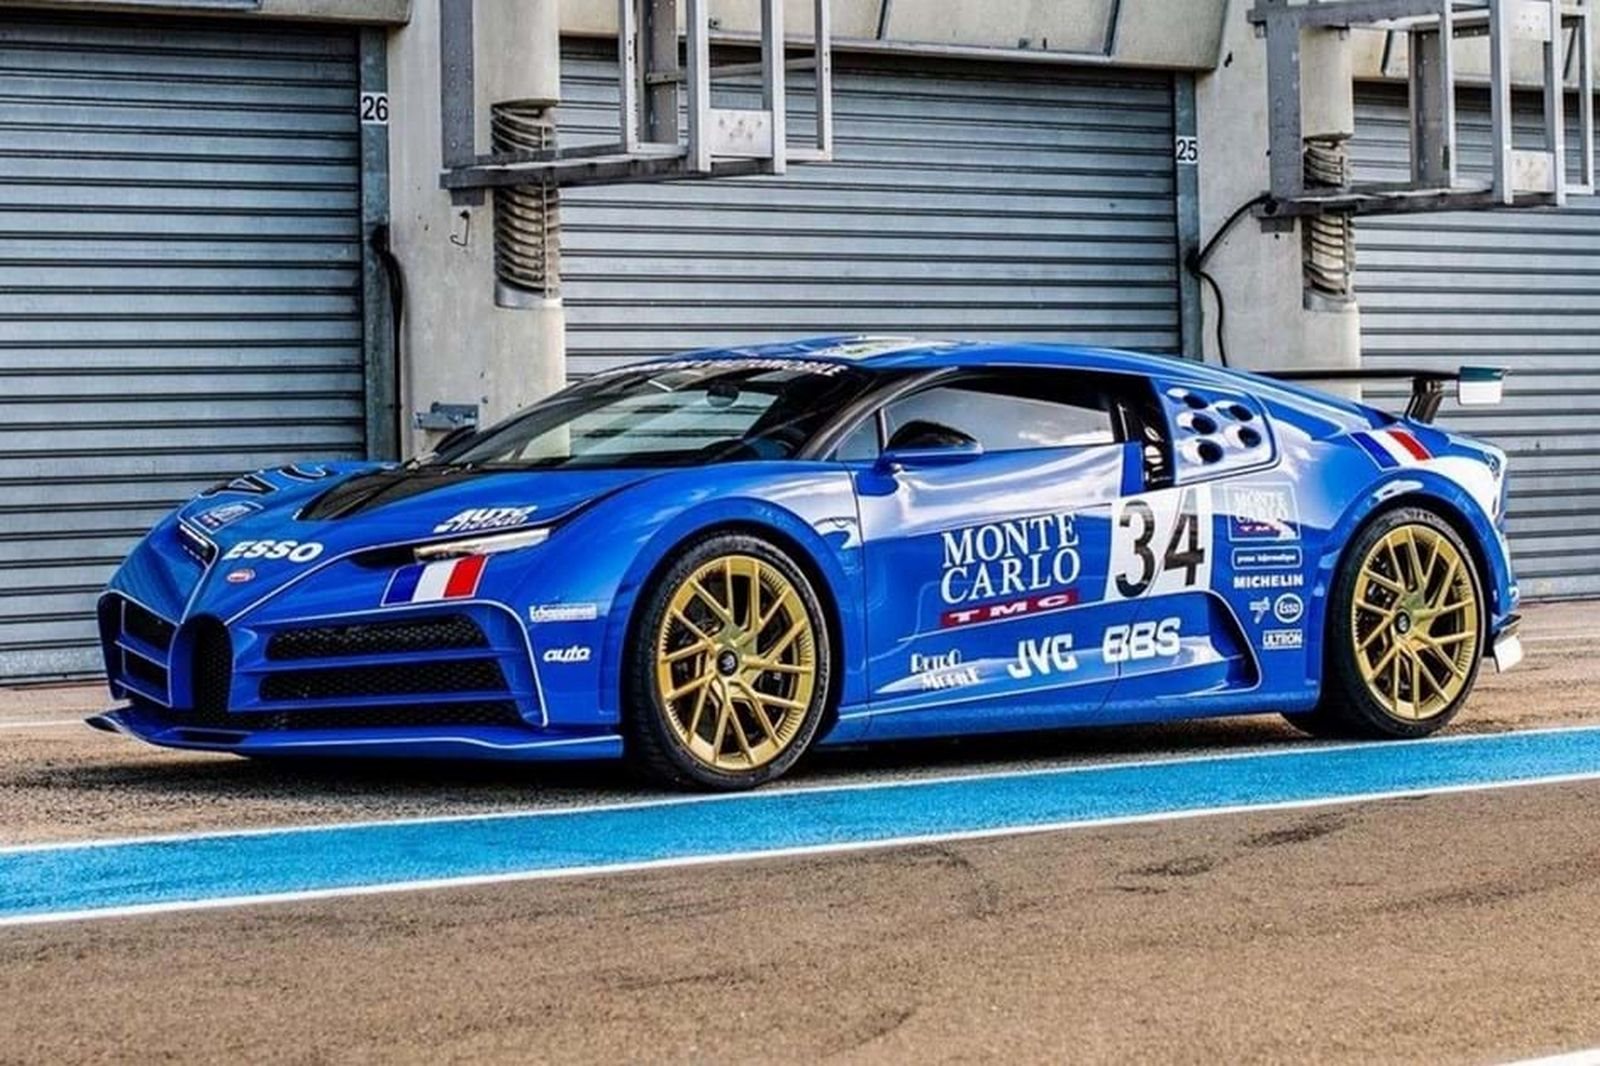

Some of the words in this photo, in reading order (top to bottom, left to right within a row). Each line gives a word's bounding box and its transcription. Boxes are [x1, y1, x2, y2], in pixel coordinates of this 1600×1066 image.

[362, 95, 388, 121] 26
[1177, 139, 1198, 161] 25
[221, 540, 324, 563] ESSO
[941, 512, 1080, 568] MONTE
[1115, 500, 1205, 598] 34
[940, 548, 1081, 604] CARLO
[1233, 574, 1304, 589] MICHELIN
[949, 594, 1070, 623] TMC
[543, 645, 591, 662] auto
[1103, 617, 1181, 663] BBS
[1008, 634, 1078, 678] JVC
